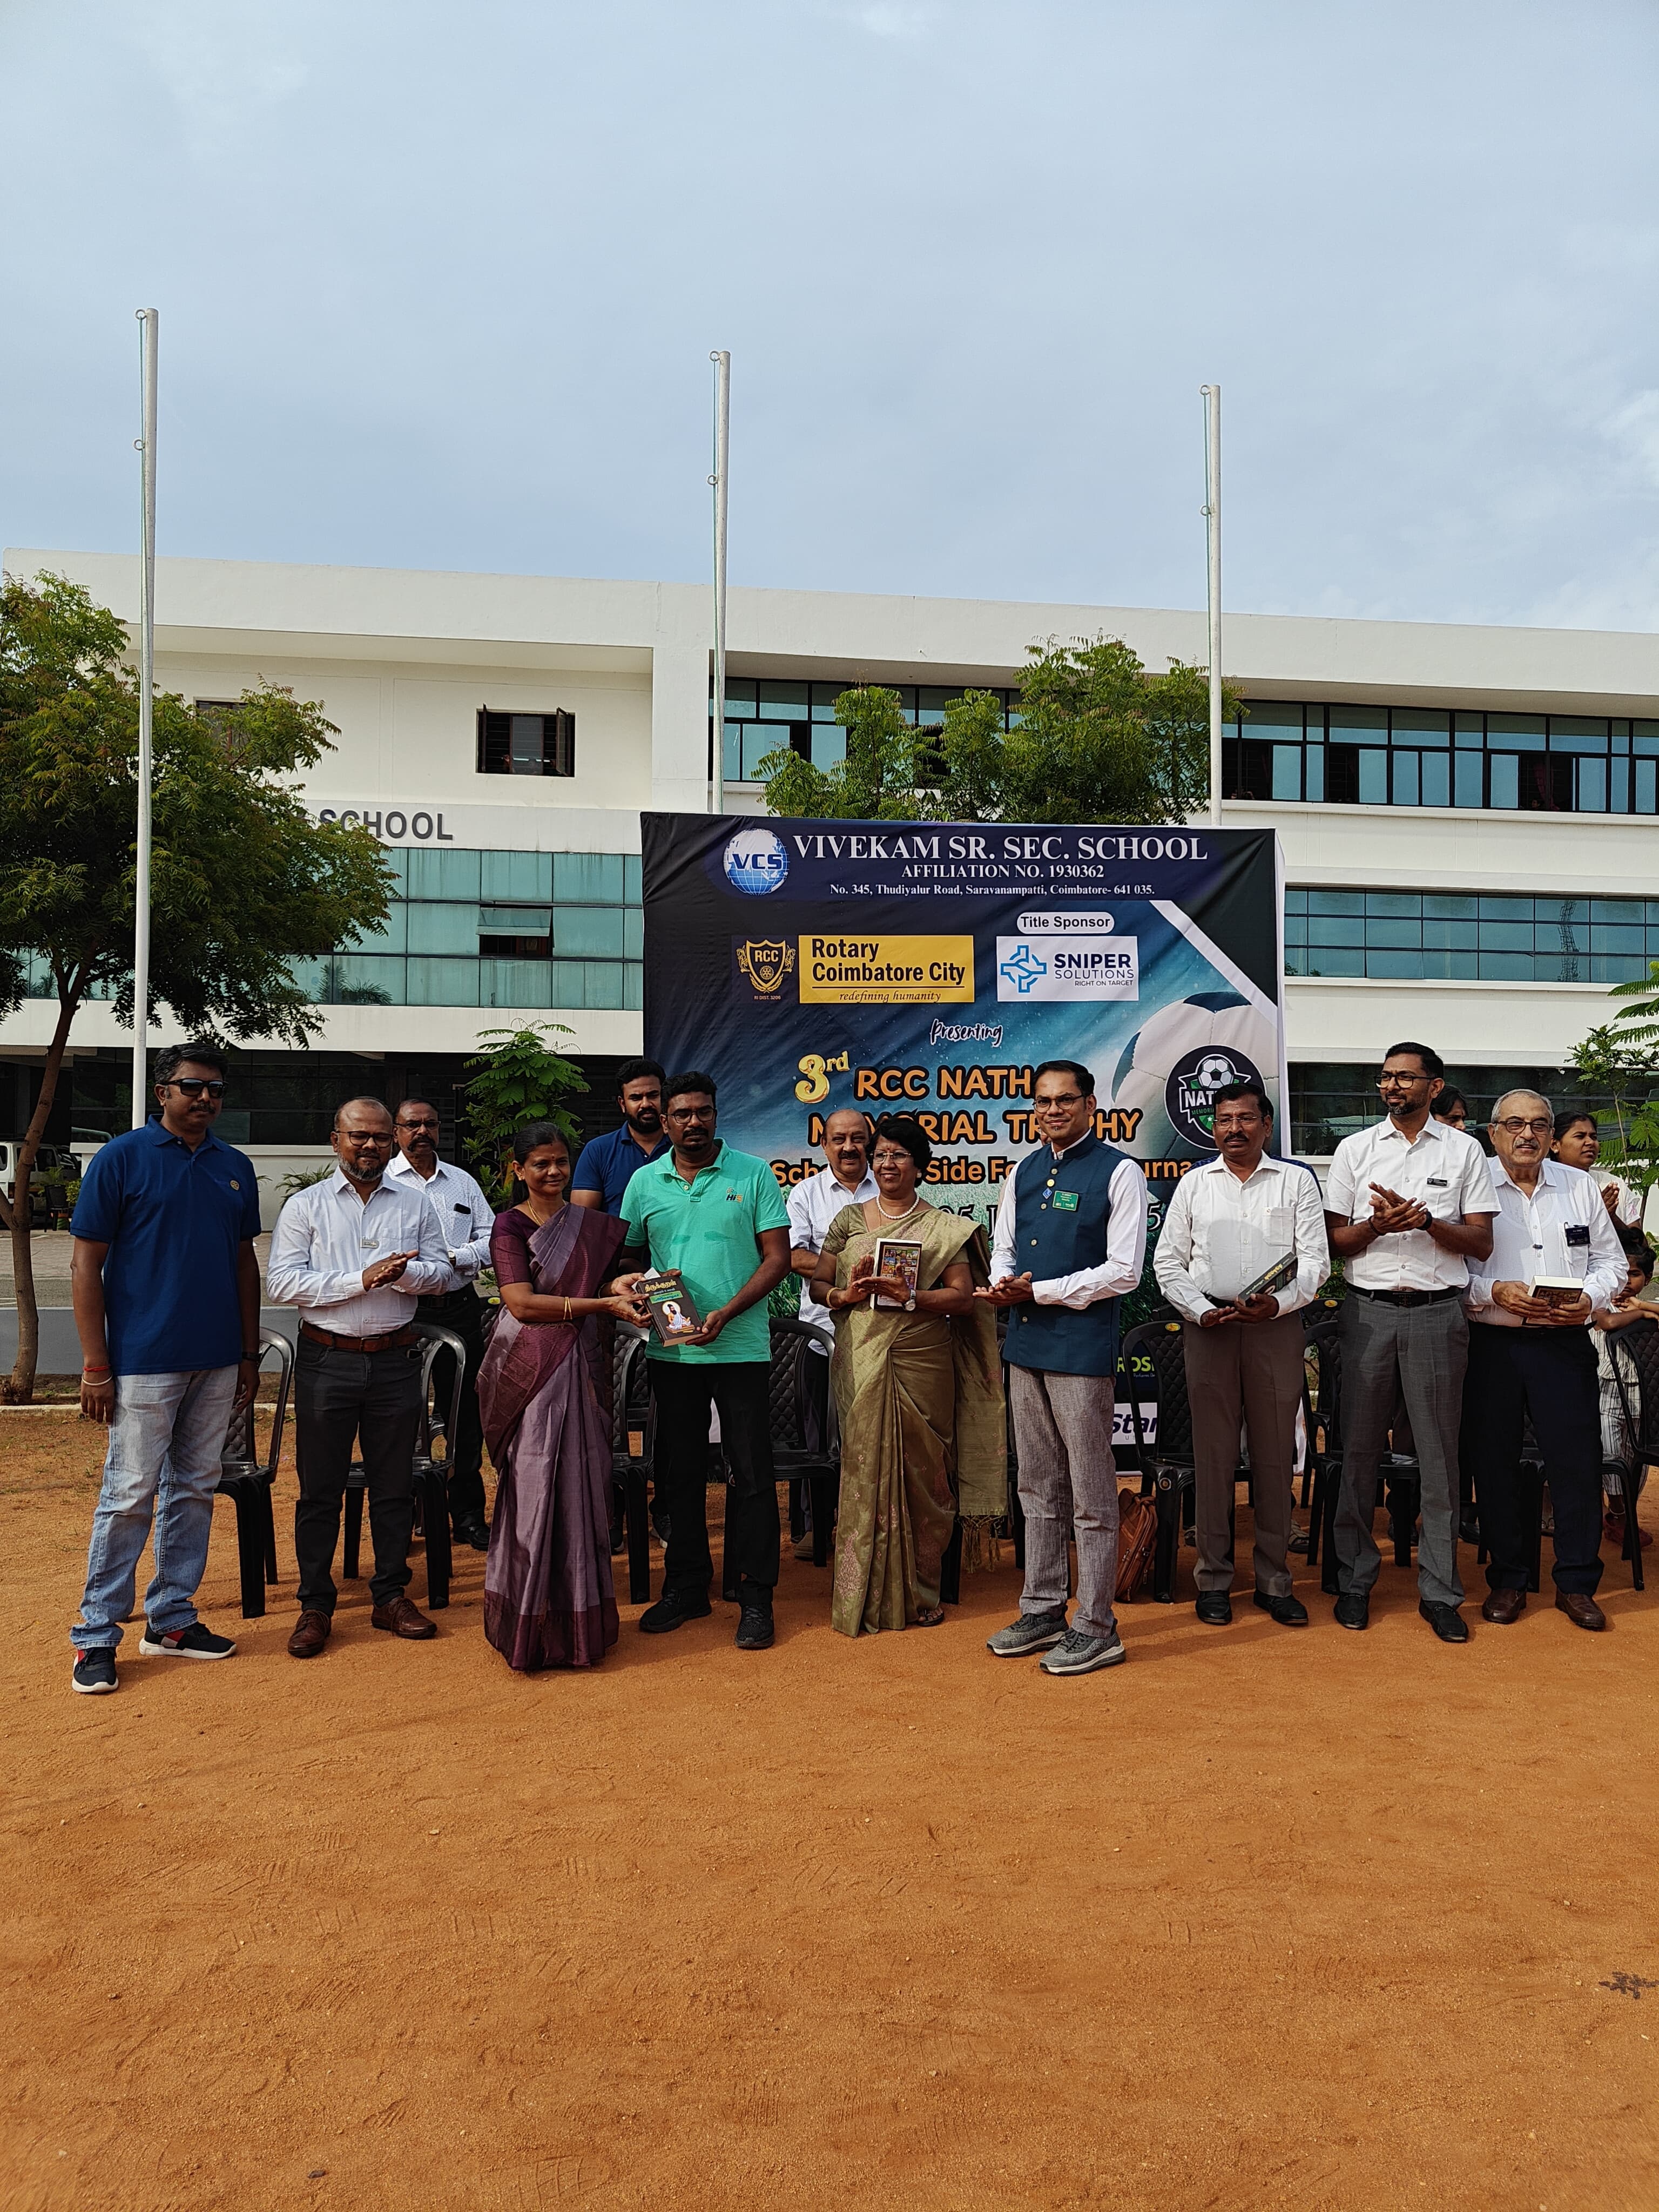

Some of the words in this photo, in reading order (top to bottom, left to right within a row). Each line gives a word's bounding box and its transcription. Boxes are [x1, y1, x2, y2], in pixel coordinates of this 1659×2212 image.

[793, 835, 941, 859] VIVEKAM
[949, 836, 995, 859] SR.
[1003, 836, 1069, 860] SEC.
[1078, 837, 1208, 860] SCHOOL
[732, 853, 783, 870] VCS
[901, 865, 1009, 878] AFFILIATION
[1015, 865, 1044, 878] NO.
[1049, 865, 1104, 878] 1930362
[830, 885, 848, 894] No.
[851, 885, 873, 896] 345,
[876, 885, 930, 896] Thudiyalur
[933, 885, 963, 896] Road,
[966, 885, 1047, 896] Saravanampatti,
[1050, 885, 1111, 895] Coimbatore-
[1114, 885, 1131, 894] 641
[1134, 885, 1155, 894] 035.
[1021, 916, 1049, 927] Title
[1054, 916, 1110, 930] Sponsor
[754, 950, 779, 962] RCC
[812, 938, 879, 962] Rotary
[1054, 953, 1131, 968] SNIPER
[812, 962, 924, 982] Coimbatore
[929, 962, 966, 985] City
[1055, 969, 1134, 979] SOLUTIONS
[839, 990, 889, 1003] redefining
[893, 990, 941, 1003] humanity
[930, 1019, 1003, 1047] Presenting
[795, 1051, 849, 1104] 3rd
[857, 1069, 927, 1098] RCC
